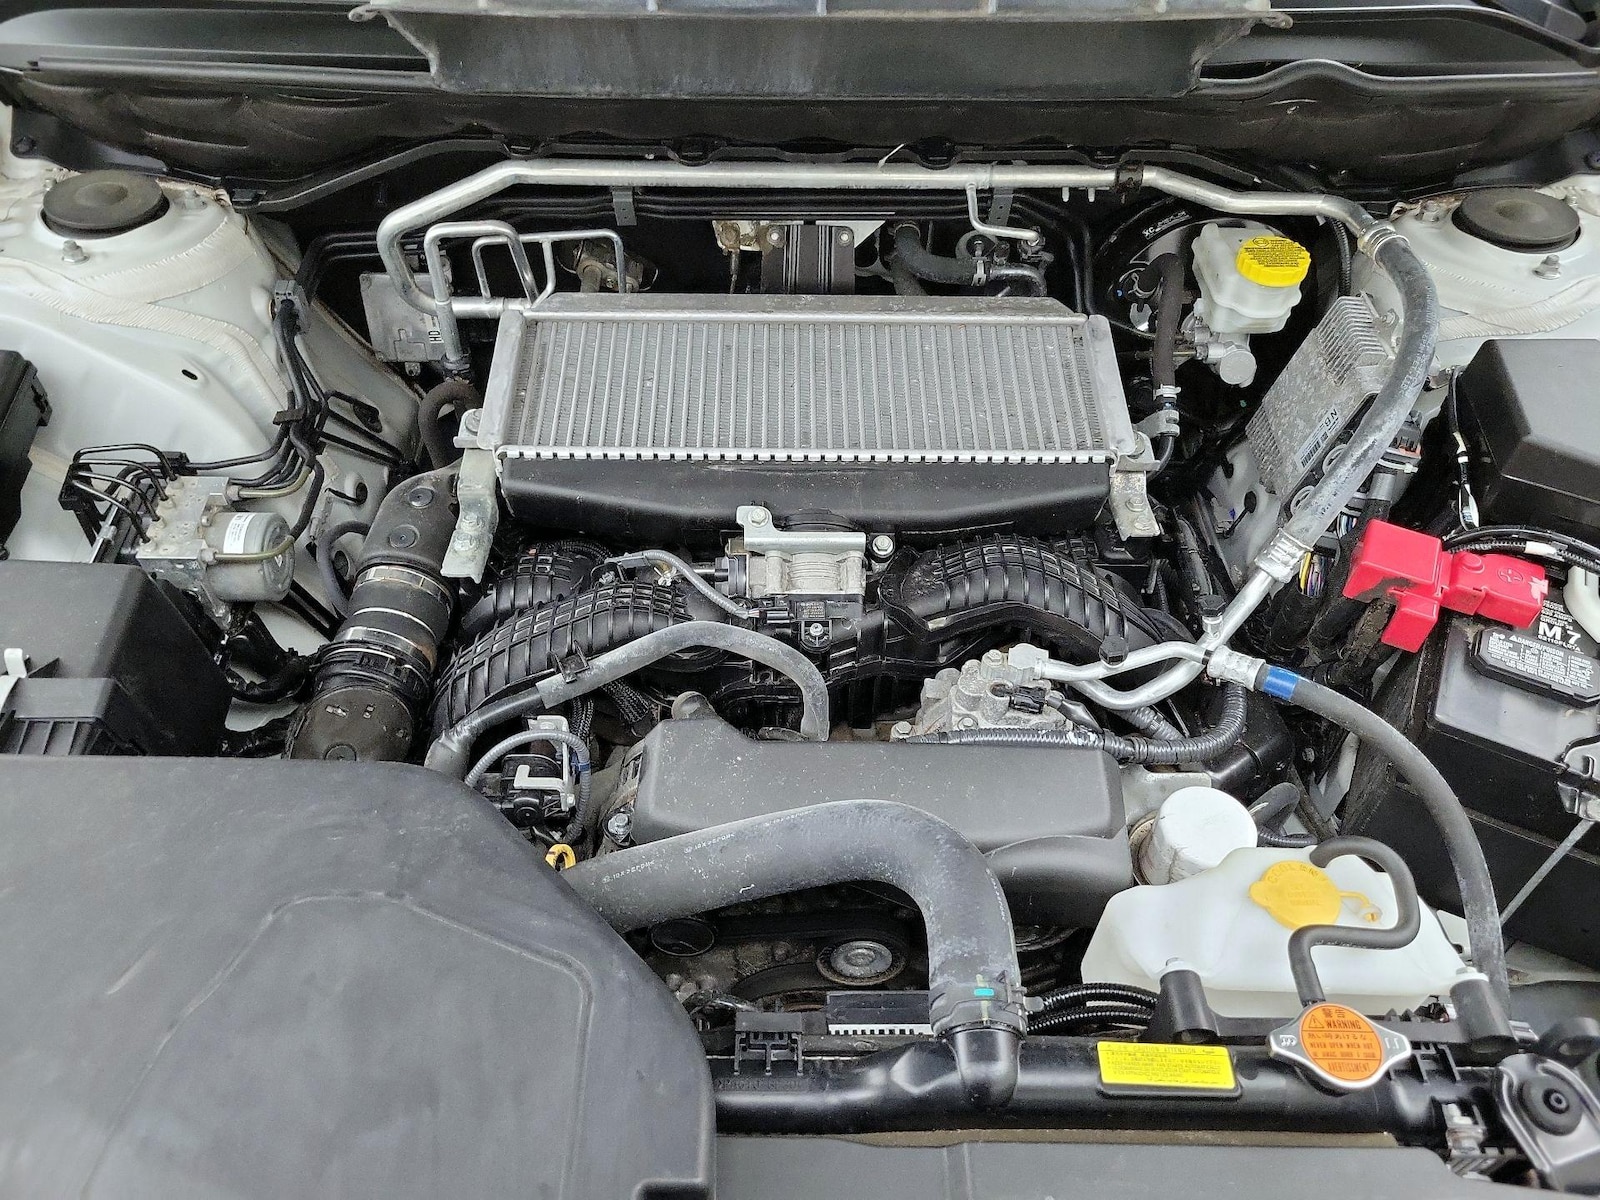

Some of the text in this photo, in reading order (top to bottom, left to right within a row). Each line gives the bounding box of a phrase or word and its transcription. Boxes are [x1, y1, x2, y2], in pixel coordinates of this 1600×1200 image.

[428, 330, 442, 342] HD
[1326, 1019, 1362, 1030] WARNING
[1133, 1045, 1160, 1053] CAUTION
